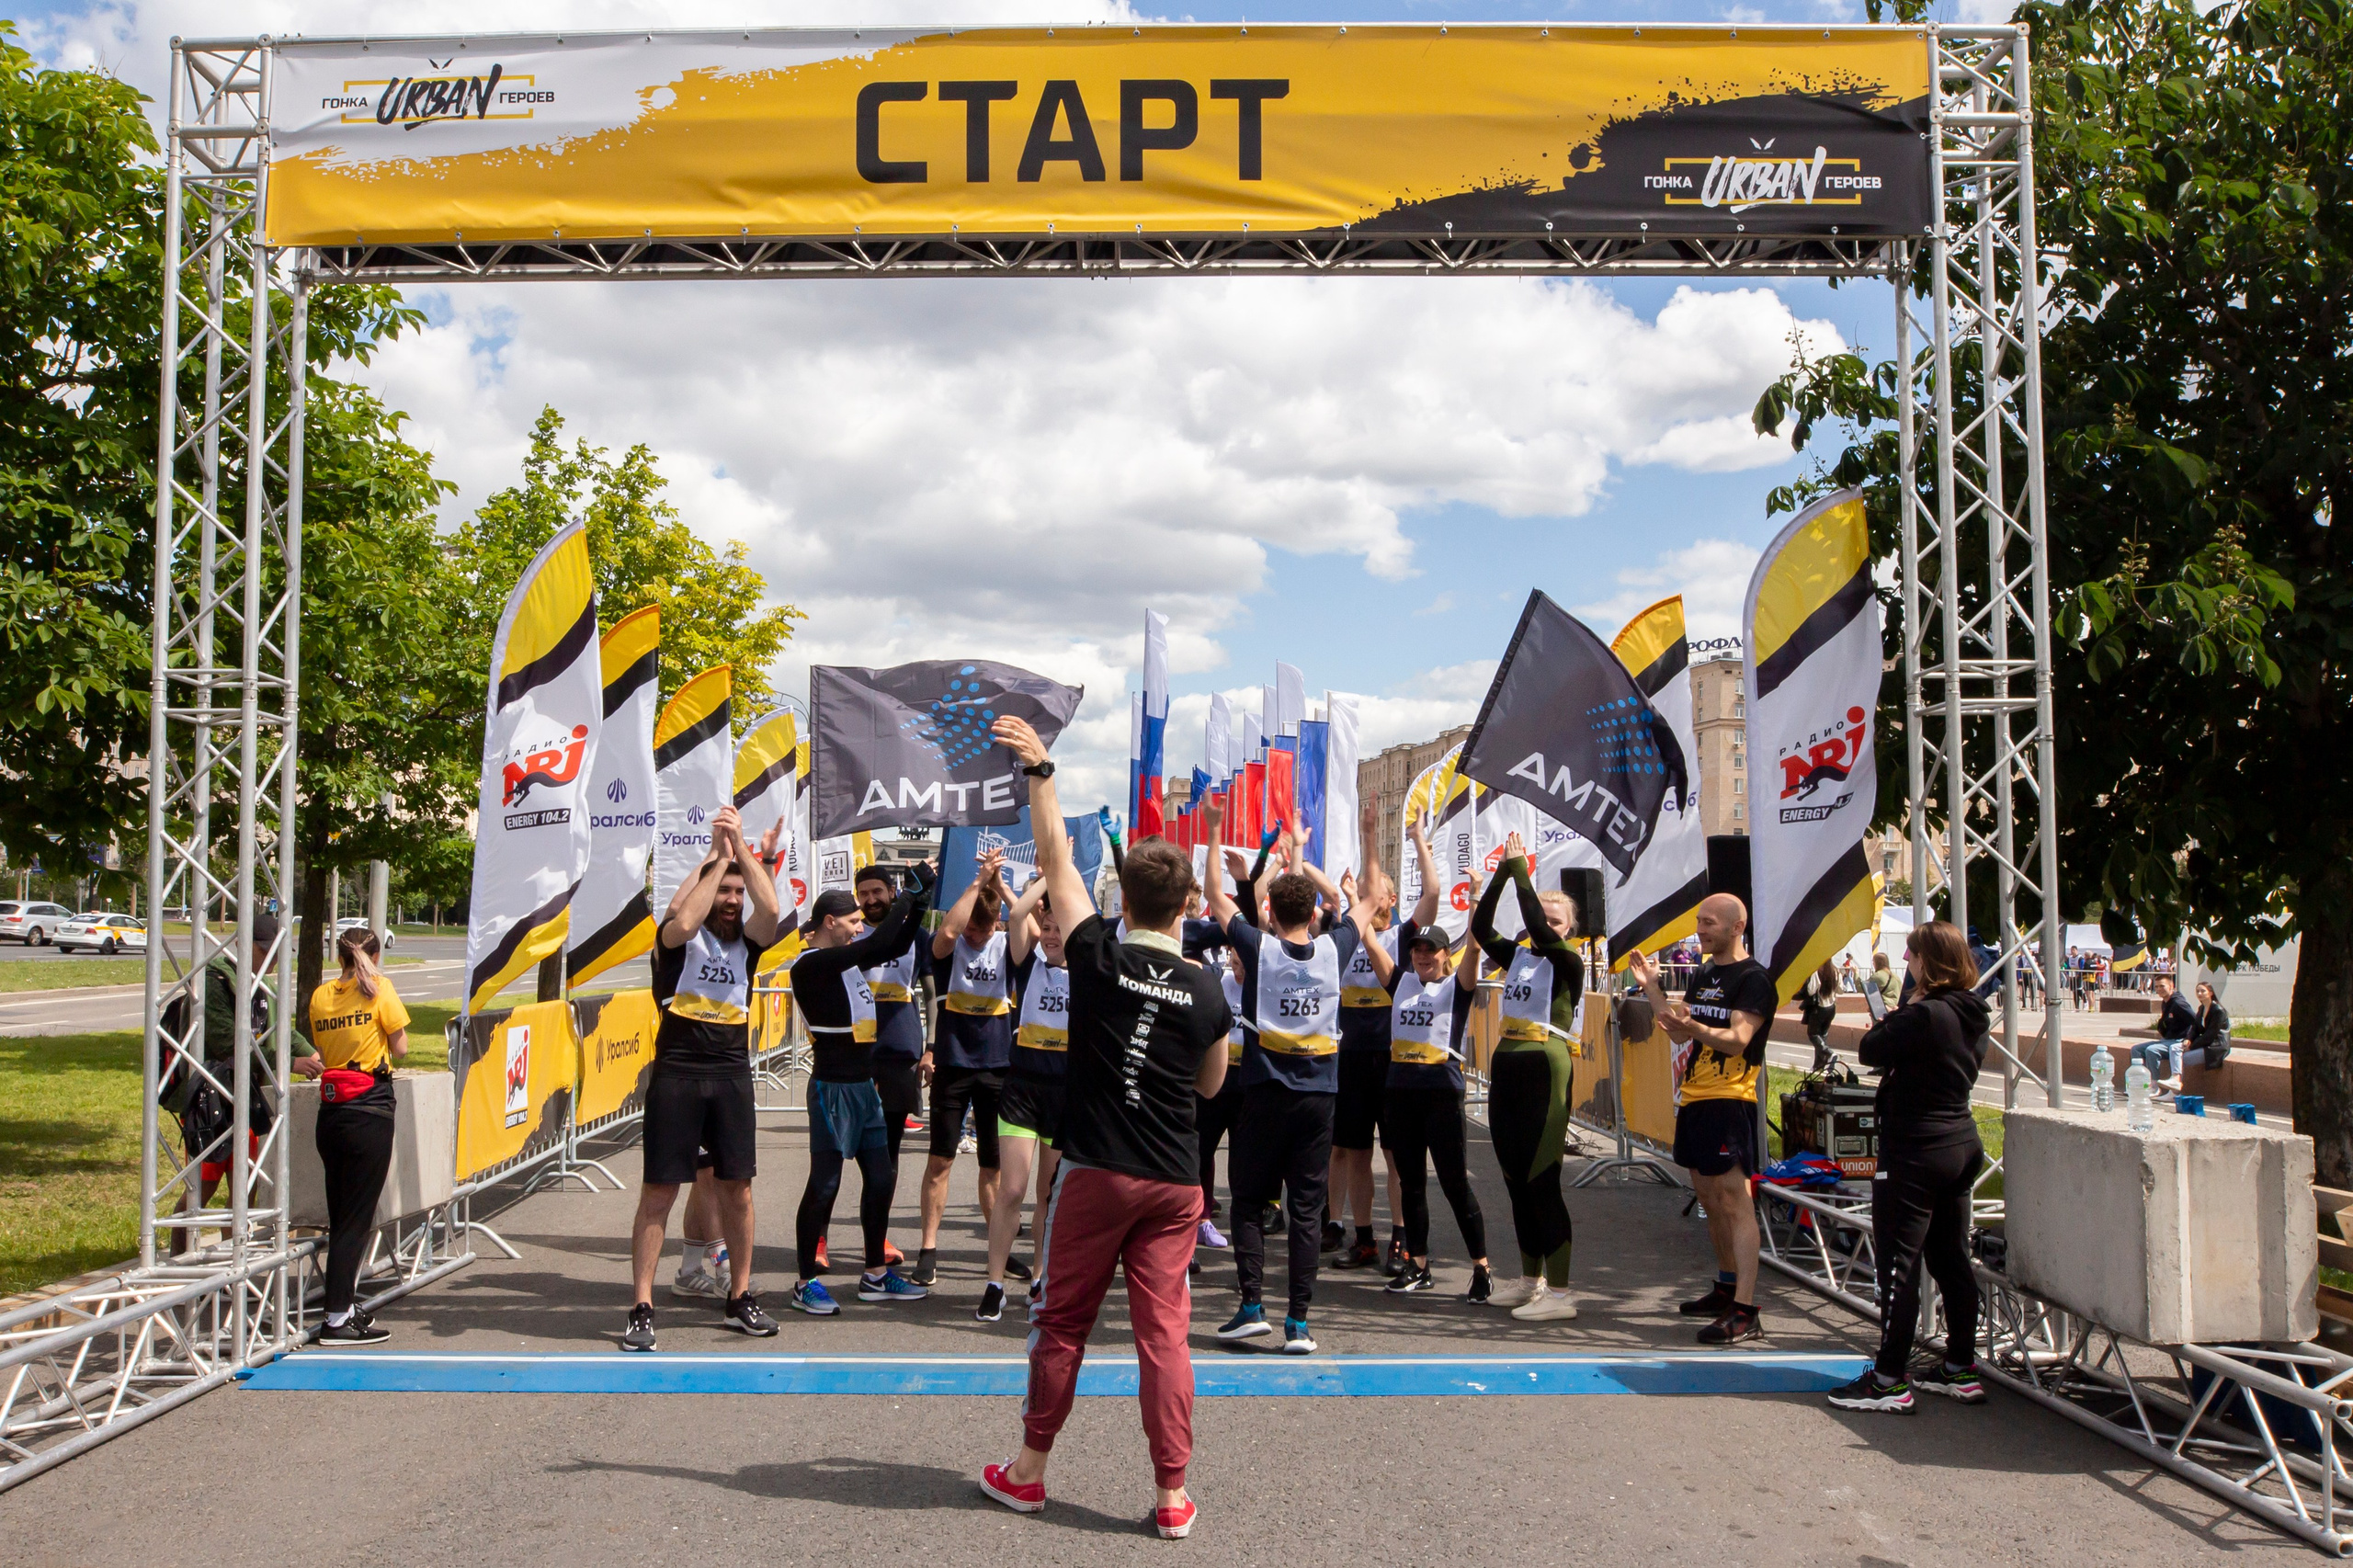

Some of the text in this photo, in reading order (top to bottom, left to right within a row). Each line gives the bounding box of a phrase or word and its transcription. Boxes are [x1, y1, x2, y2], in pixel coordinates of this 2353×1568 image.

[322, 63, 555, 128] ГОНКА URBAN ГЕРОЕВ
[856, 79, 1290, 184] СТАРТ
[1643, 145, 1882, 210] ГОНКА URBAN ГЕРОЕВ
[1688, 637, 1744, 652] РОФЛ
[1779, 722, 1845, 756] РАДИО
[856, 768, 1018, 816] AMTE
[1506, 751, 1647, 862] AMTEX
[506, 810, 569, 829] ENERGY 104.2
[589, 811, 655, 830] ралсиб
[1781, 808, 1830, 822] ENERGY
[1457, 833, 1470, 875] KUDAGO
[698, 964, 735, 984] 5251
[1118, 974, 1193, 1006] КОМАНДА
[314, 1010, 373, 1032] ОЛОНТЁР
[1279, 997, 1320, 1017] 5263
[1400, 1010, 1434, 1027] 5252
[606, 1031, 640, 1064] Уралсиб
